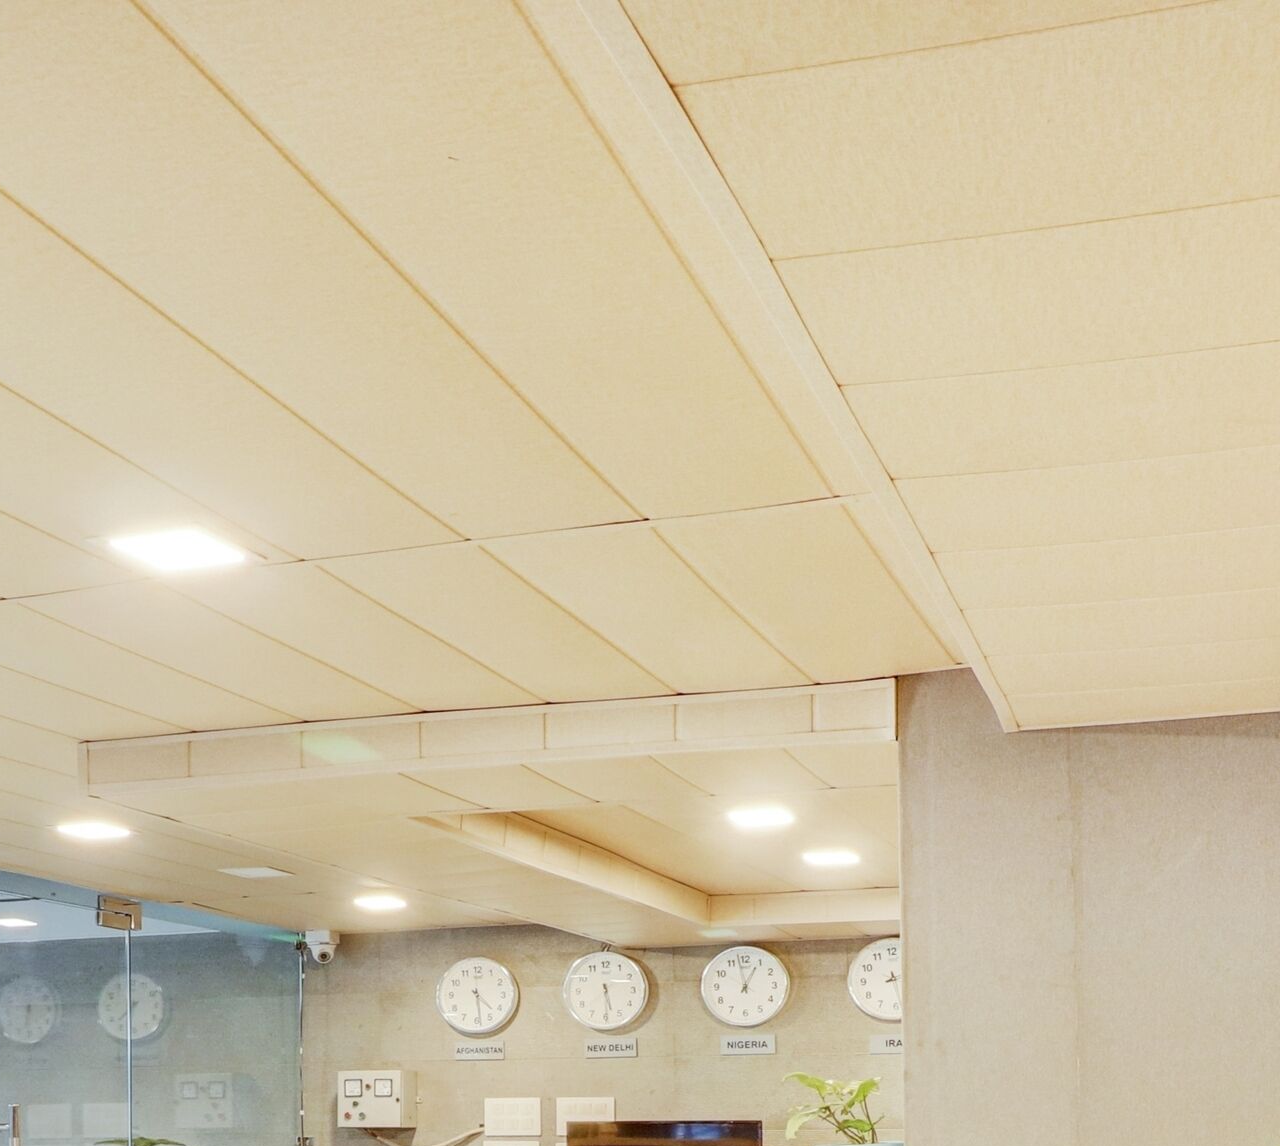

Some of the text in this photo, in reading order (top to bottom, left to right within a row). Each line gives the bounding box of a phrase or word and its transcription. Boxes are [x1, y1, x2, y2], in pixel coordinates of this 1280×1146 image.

[887, 947, 897, 956] 12
[740, 955, 751, 964] 12
[473, 966, 482, 974] 12
[767, 968, 774, 976] 2
[862, 964, 873, 972] 10
[717, 970, 726, 978] 10
[771, 981, 778, 989] 3
[860, 978, 867, 986] 9
[713, 983, 720, 991] 9
[865, 991, 872, 999] 8
[718, 996, 724, 1005] 8
[877, 1000, 883, 1008] 7
[728, 1006, 734, 1014] 7
[742, 1009, 749, 1017] 6
[757, 1005, 763, 1013] 5
[589, 1010, 595, 1018] 7
[726, 1040, 768, 1049] NIGERIA
[885, 1039, 903, 1047] IRA
[587, 1044, 634, 1052] NEW DELHI
